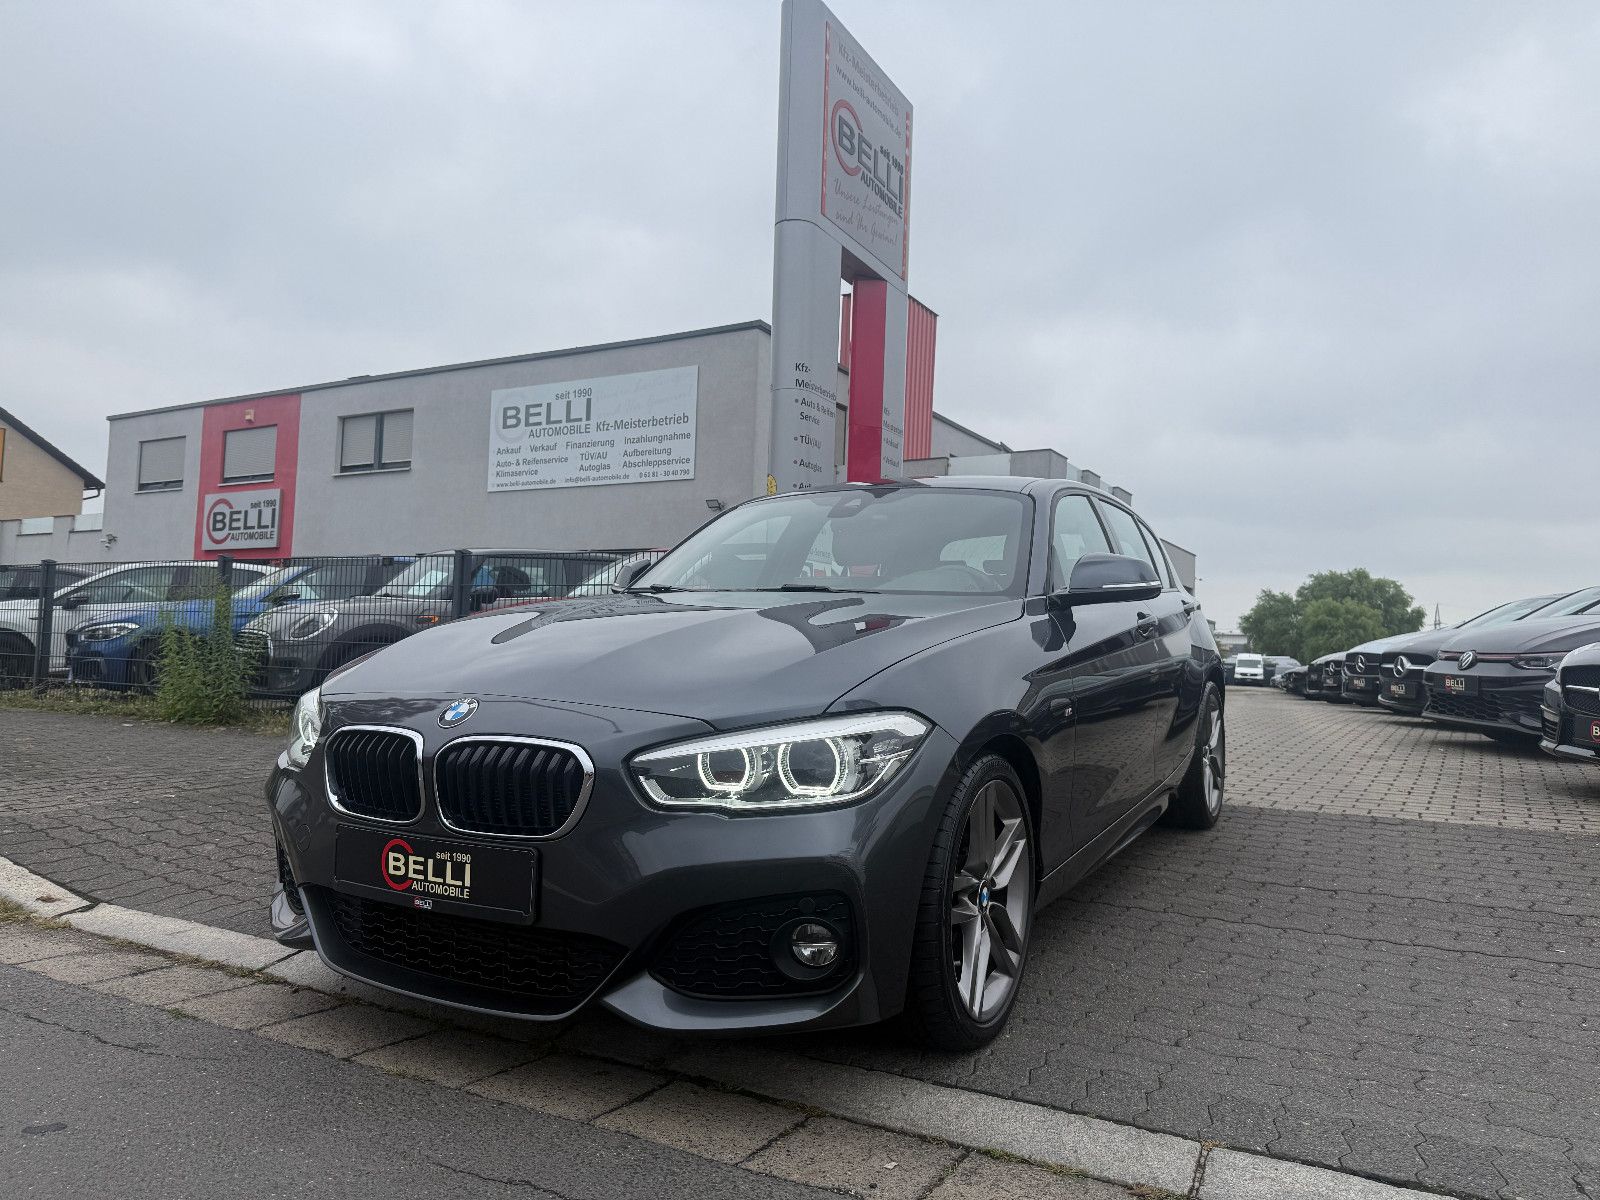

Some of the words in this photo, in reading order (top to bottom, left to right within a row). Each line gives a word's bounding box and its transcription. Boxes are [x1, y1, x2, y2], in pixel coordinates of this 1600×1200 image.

[838, 113, 904, 204] BELLI
[861, 170, 904, 220] AUTOMOBILE
[795, 362, 811, 372] Kfz-
[555, 391, 570, 401] seit
[573, 387, 592, 399] 1990
[795, 378, 837, 401] Meisterbetrieb
[502, 397, 592, 430] BELLI
[596, 412, 689, 432] Kfz-Meisterbetrieb
[800, 411, 820, 426] Service
[528, 423, 591, 439] AUTOMOBILE
[496, 445, 521, 455] Ankauf
[529, 442, 557, 453] Verkauf
[566, 439, 615, 450] Finanzierung
[624, 432, 691, 444] Inzahlungnahme
[522, 456, 568, 466] Reifenservice
[580, 451, 607, 461] TÜV/AU
[622, 447, 672, 458] Aufbereitung
[496, 469, 538, 478] Klimaservice
[579, 463, 611, 473] Autoglas
[622, 456, 691, 468] Abschleppservice
[250, 501, 262, 509] seit
[212, 508, 276, 532] BELLI
[230, 531, 275, 541] AUTOMOBILE
[436, 851, 451, 861] seit
[452, 852, 471, 863] 1990
[388, 852, 471, 887] BELLI
[411, 881, 470, 899] AUTOMOBILE
